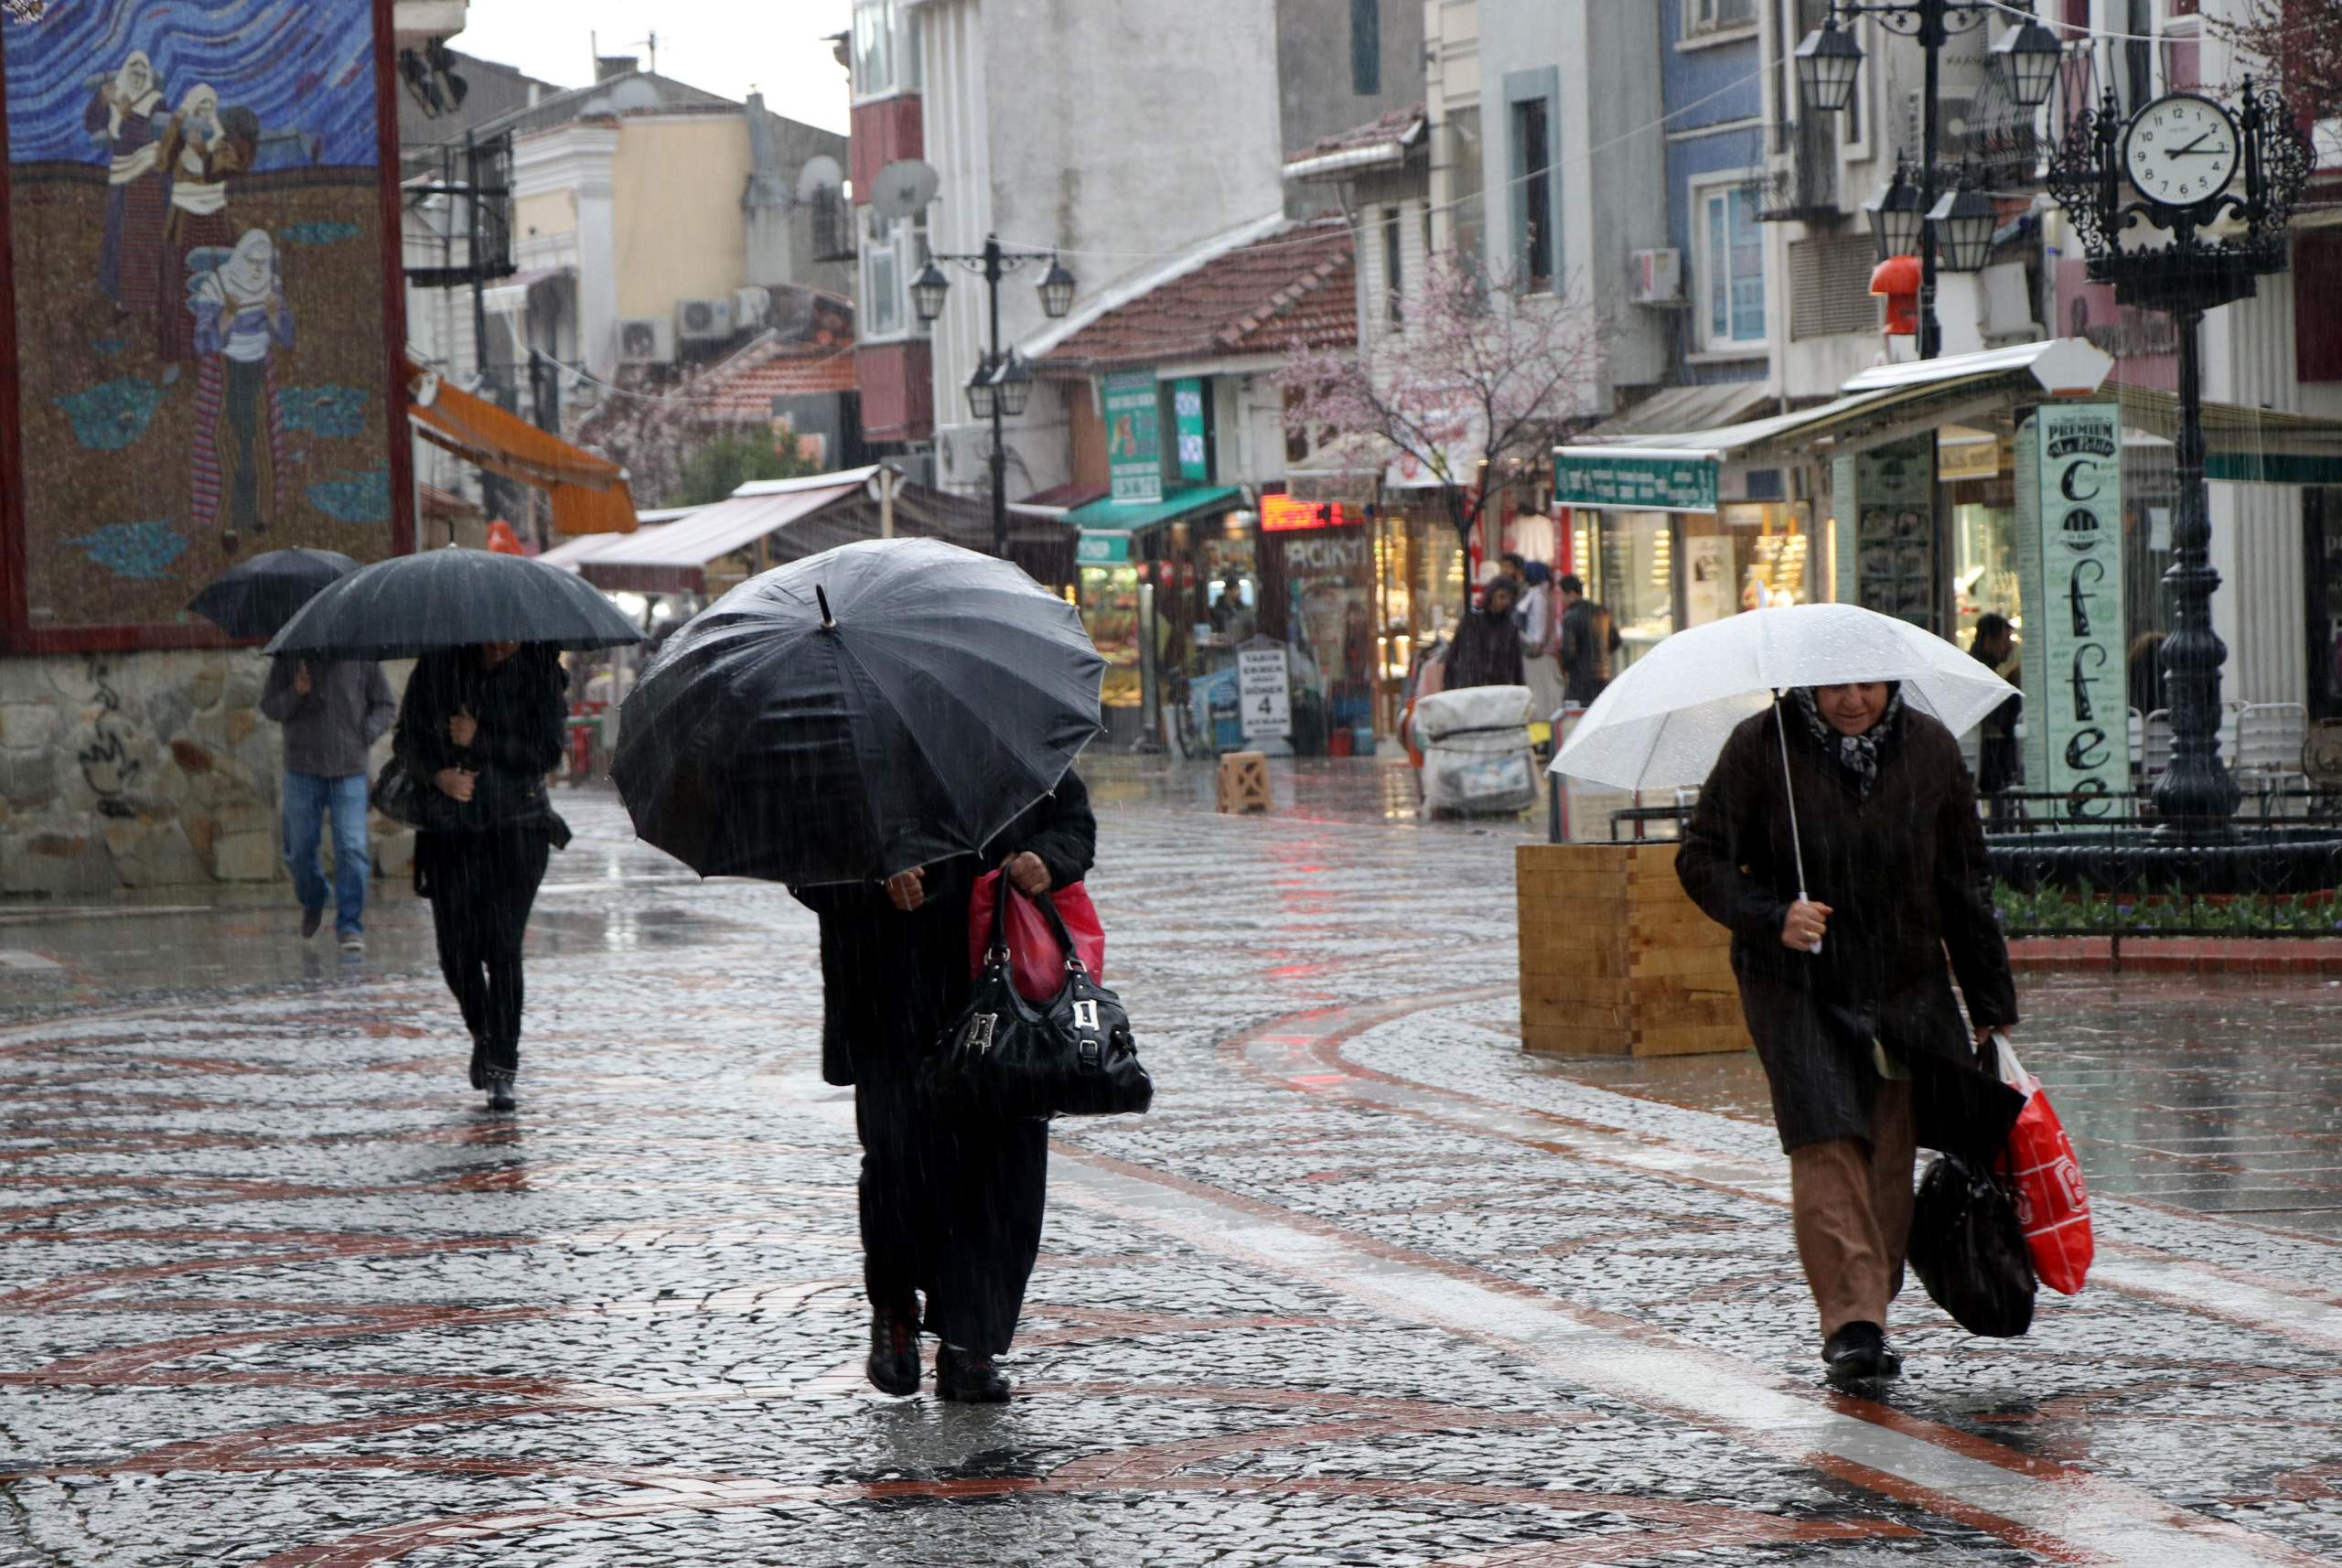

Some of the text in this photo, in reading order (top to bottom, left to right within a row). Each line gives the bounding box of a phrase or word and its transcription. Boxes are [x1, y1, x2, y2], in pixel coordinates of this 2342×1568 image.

[2173, 108, 2184, 119] 12
[2197, 111, 2202, 122] 1
[2154, 116, 2164, 126] 11
[2209, 123, 2218, 134] 2
[2142, 131, 2154, 142] 10
[2218, 141, 2226, 153] 3
[2137, 151, 2147, 162] 9
[2211, 161, 2220, 171] 4
[2144, 168, 2154, 180] 8
[2161, 180, 2169, 191] 7
[2199, 176, 2208, 188] 5
[2179, 184, 2188, 194] 6
[2048, 424, 2113, 440] PREMIUM
[1258, 695, 1272, 714] 4
